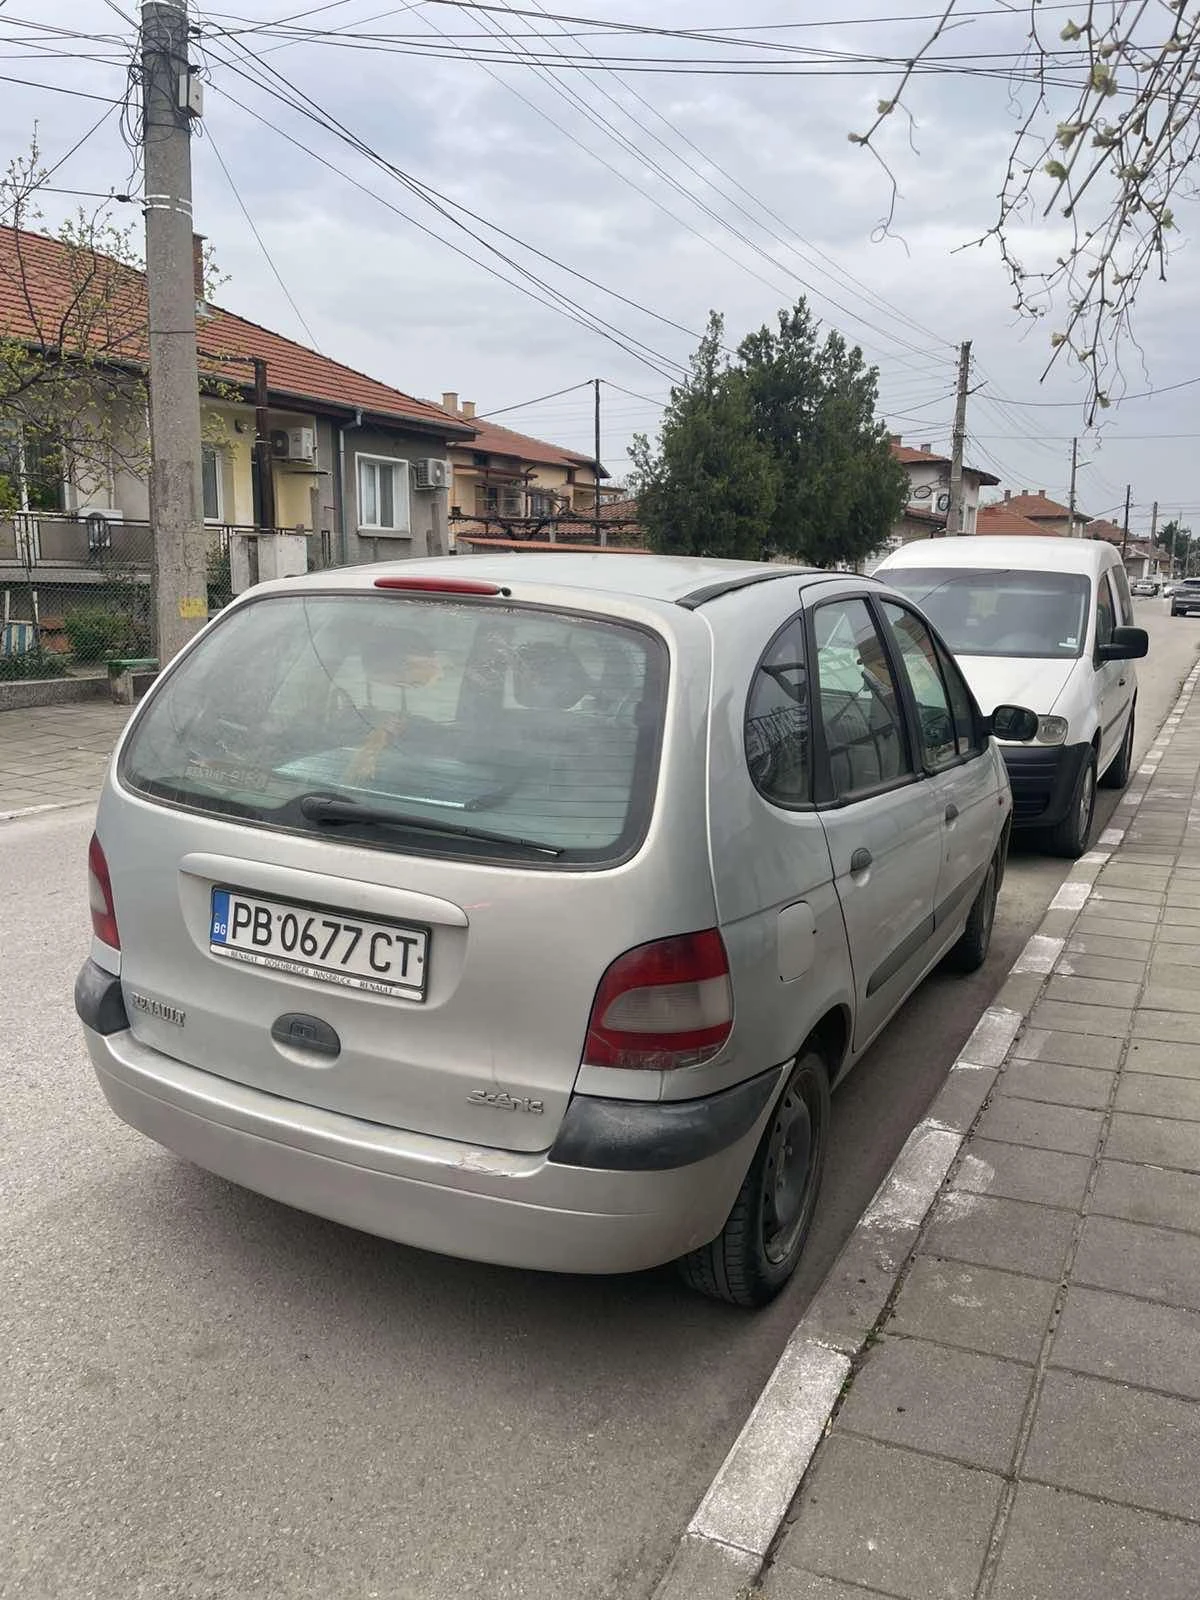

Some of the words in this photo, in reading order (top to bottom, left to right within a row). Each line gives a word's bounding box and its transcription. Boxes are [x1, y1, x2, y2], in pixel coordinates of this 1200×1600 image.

[213, 921, 227, 936] BG
[231, 902, 273, 946] PB
[280, 913, 364, 964] 0677
[369, 932, 418, 977] CT
[359, 980, 394, 995] RENAULT
[131, 991, 186, 1028] RENAULT
